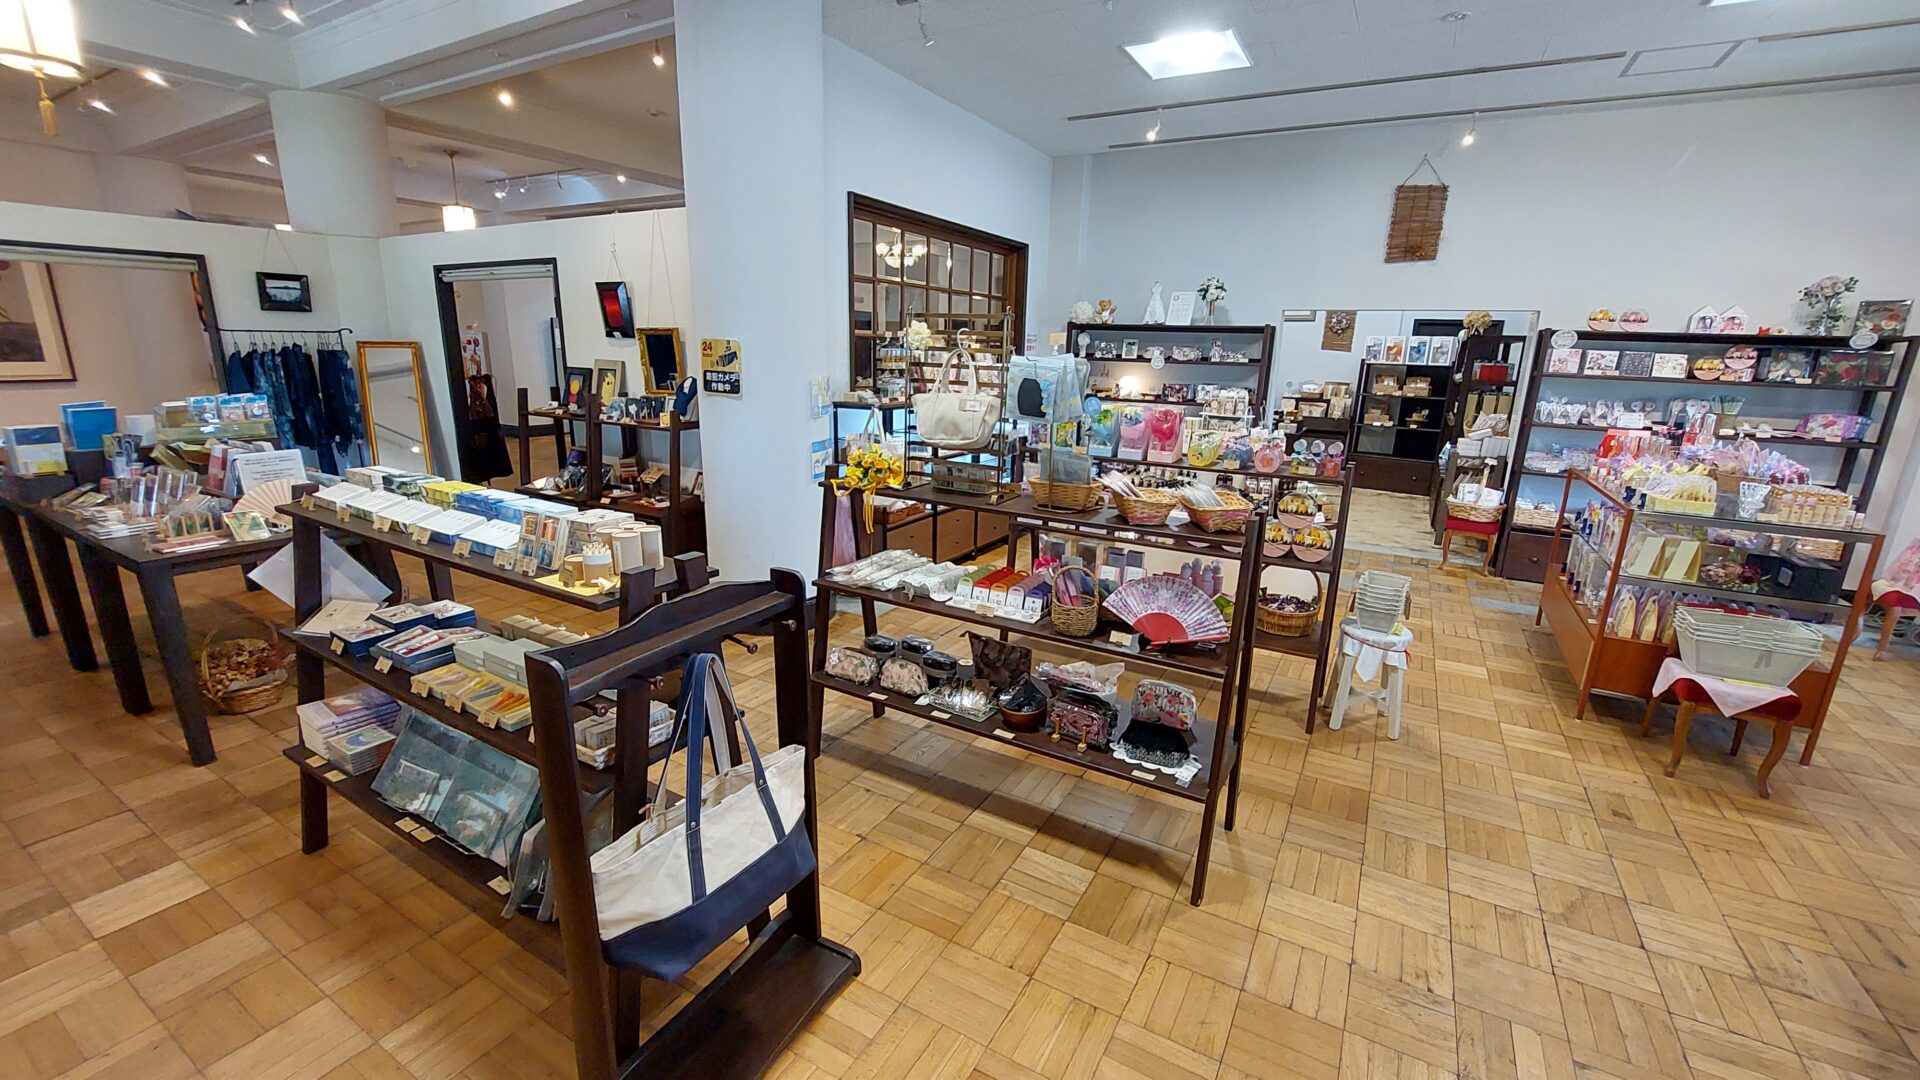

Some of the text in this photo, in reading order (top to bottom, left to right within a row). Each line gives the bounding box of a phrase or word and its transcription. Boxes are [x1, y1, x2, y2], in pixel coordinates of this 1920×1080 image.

[702, 341, 713, 351] 24
[706, 372, 736, 382] 防犯カメラ
[711, 382, 731, 392] 作動中
